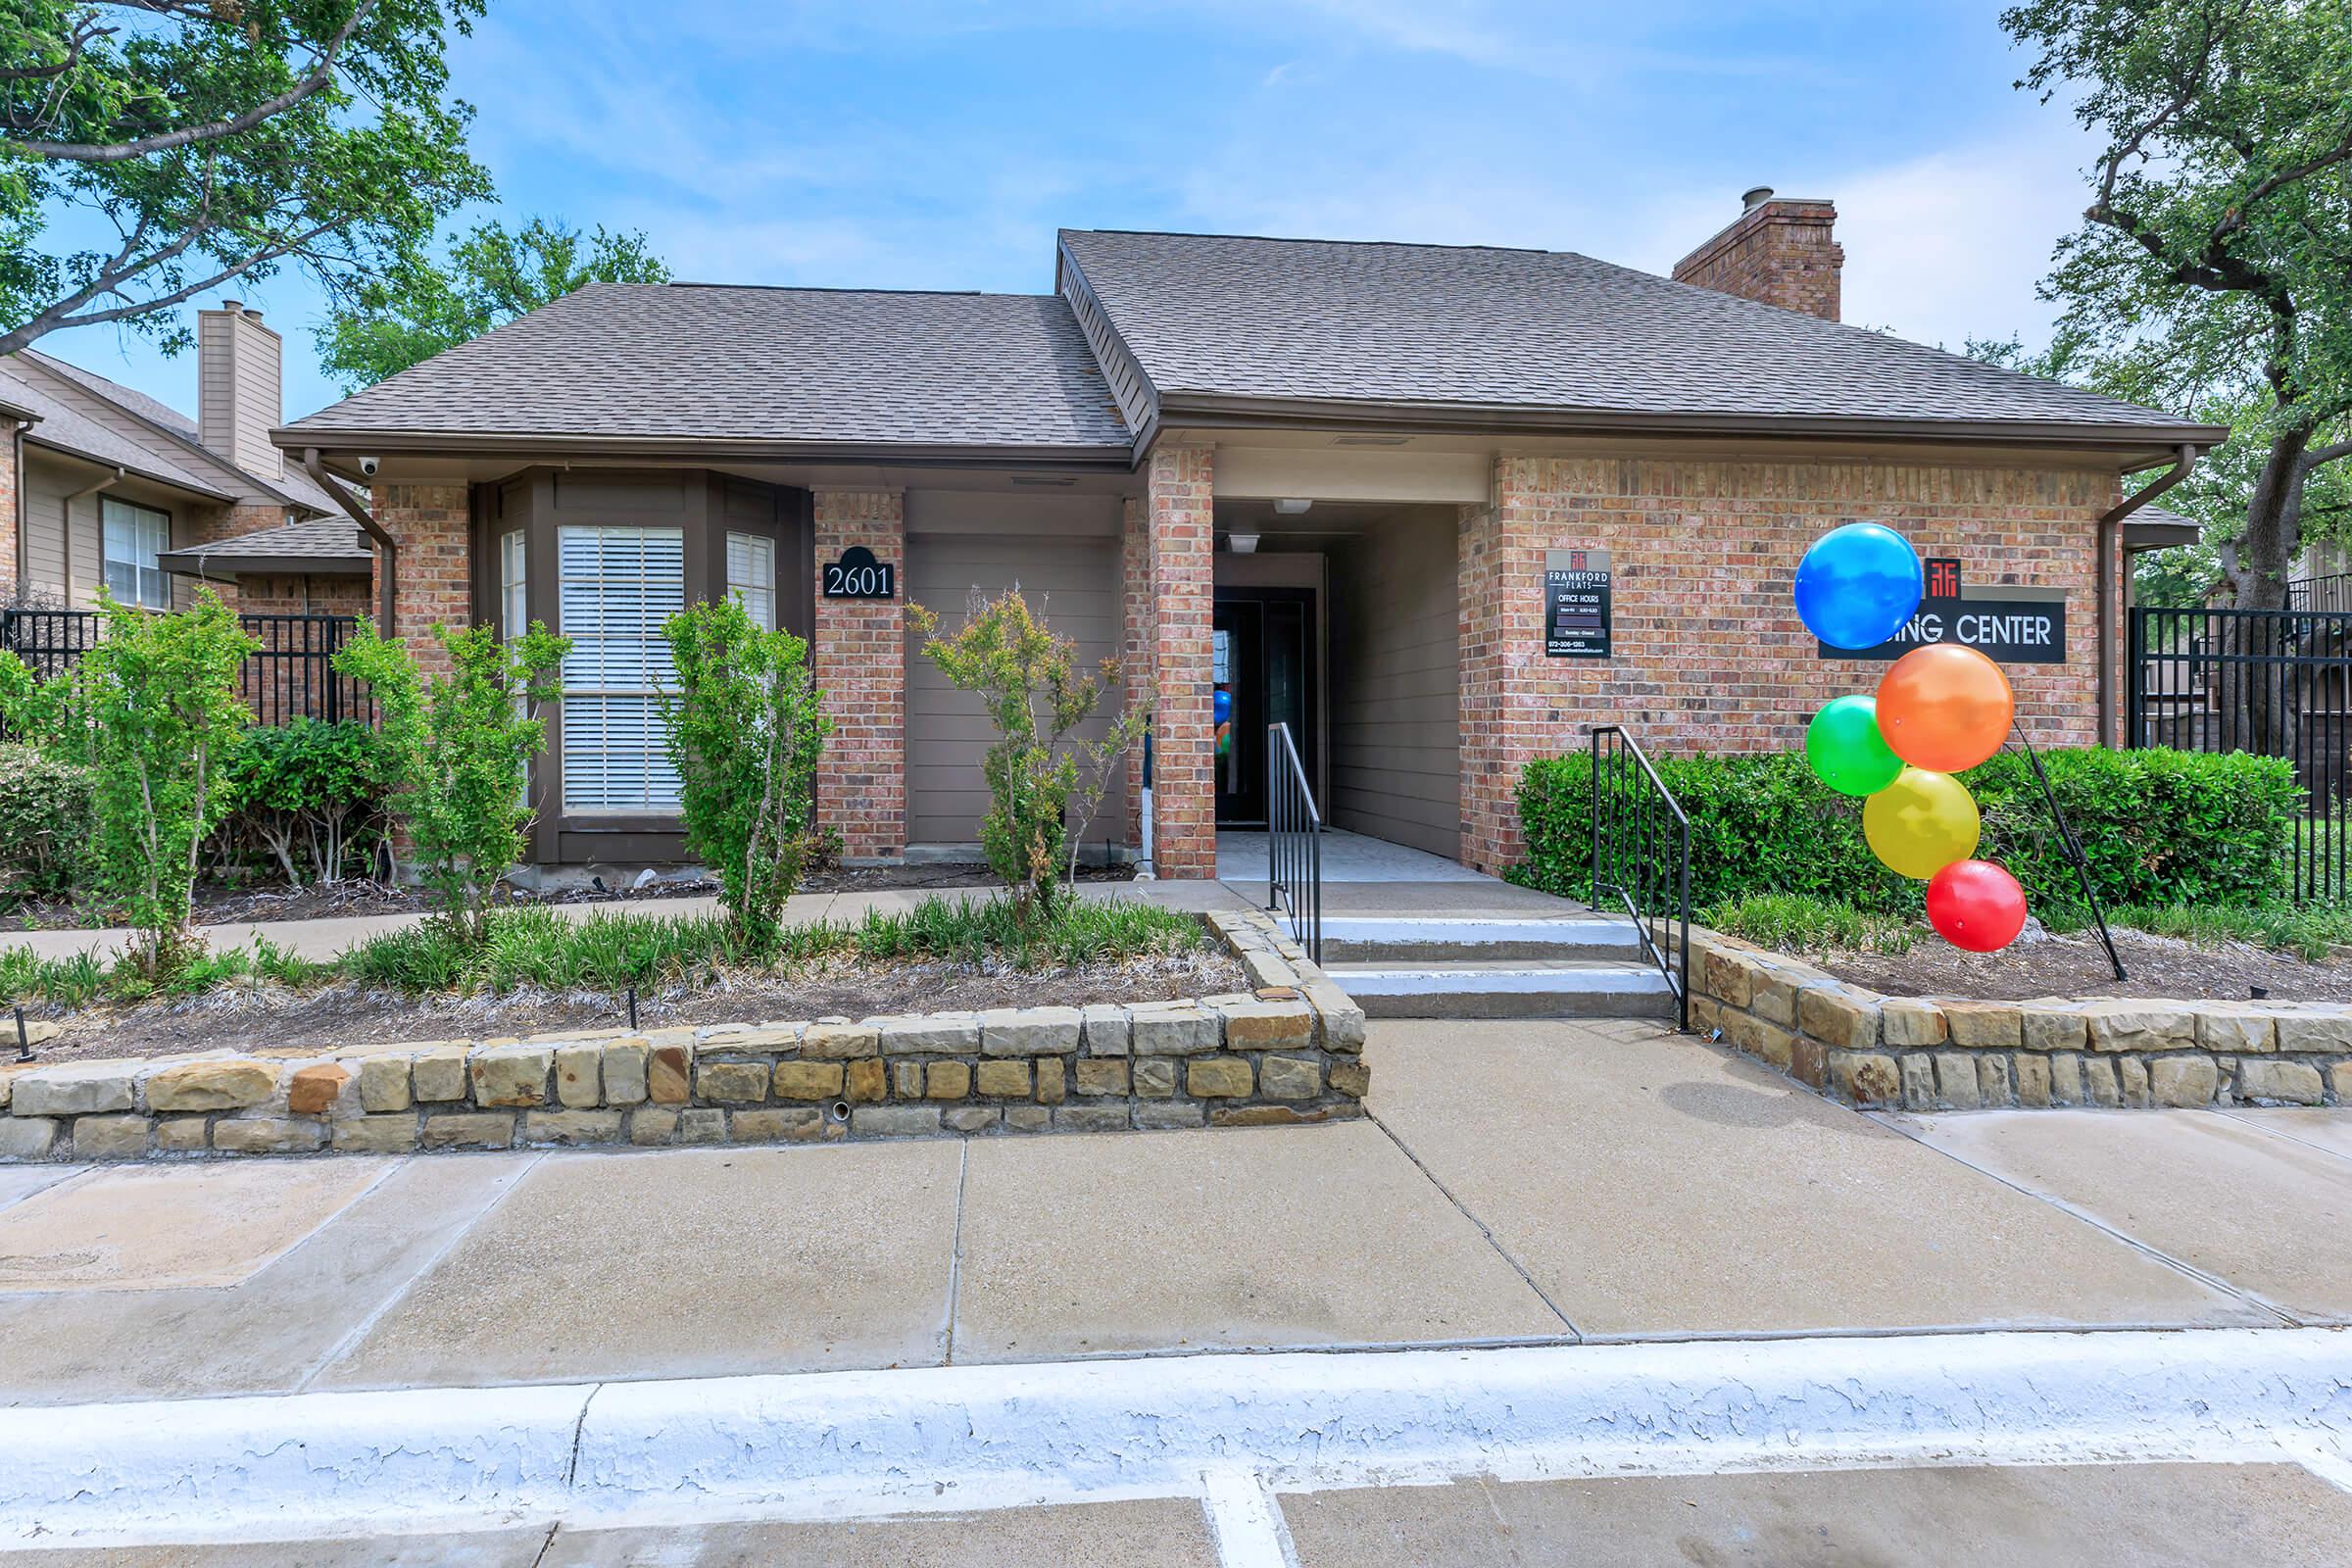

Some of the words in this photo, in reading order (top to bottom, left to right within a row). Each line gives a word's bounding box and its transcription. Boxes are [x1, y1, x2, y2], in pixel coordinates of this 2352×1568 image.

[828, 566, 890, 595] 2601
[1548, 571, 1608, 582] FRANKFORD
[1566, 581, 1592, 590] FLATS
[1580, 595, 1598, 604] HOURS
[1956, 614, 2052, 646] CENTER
